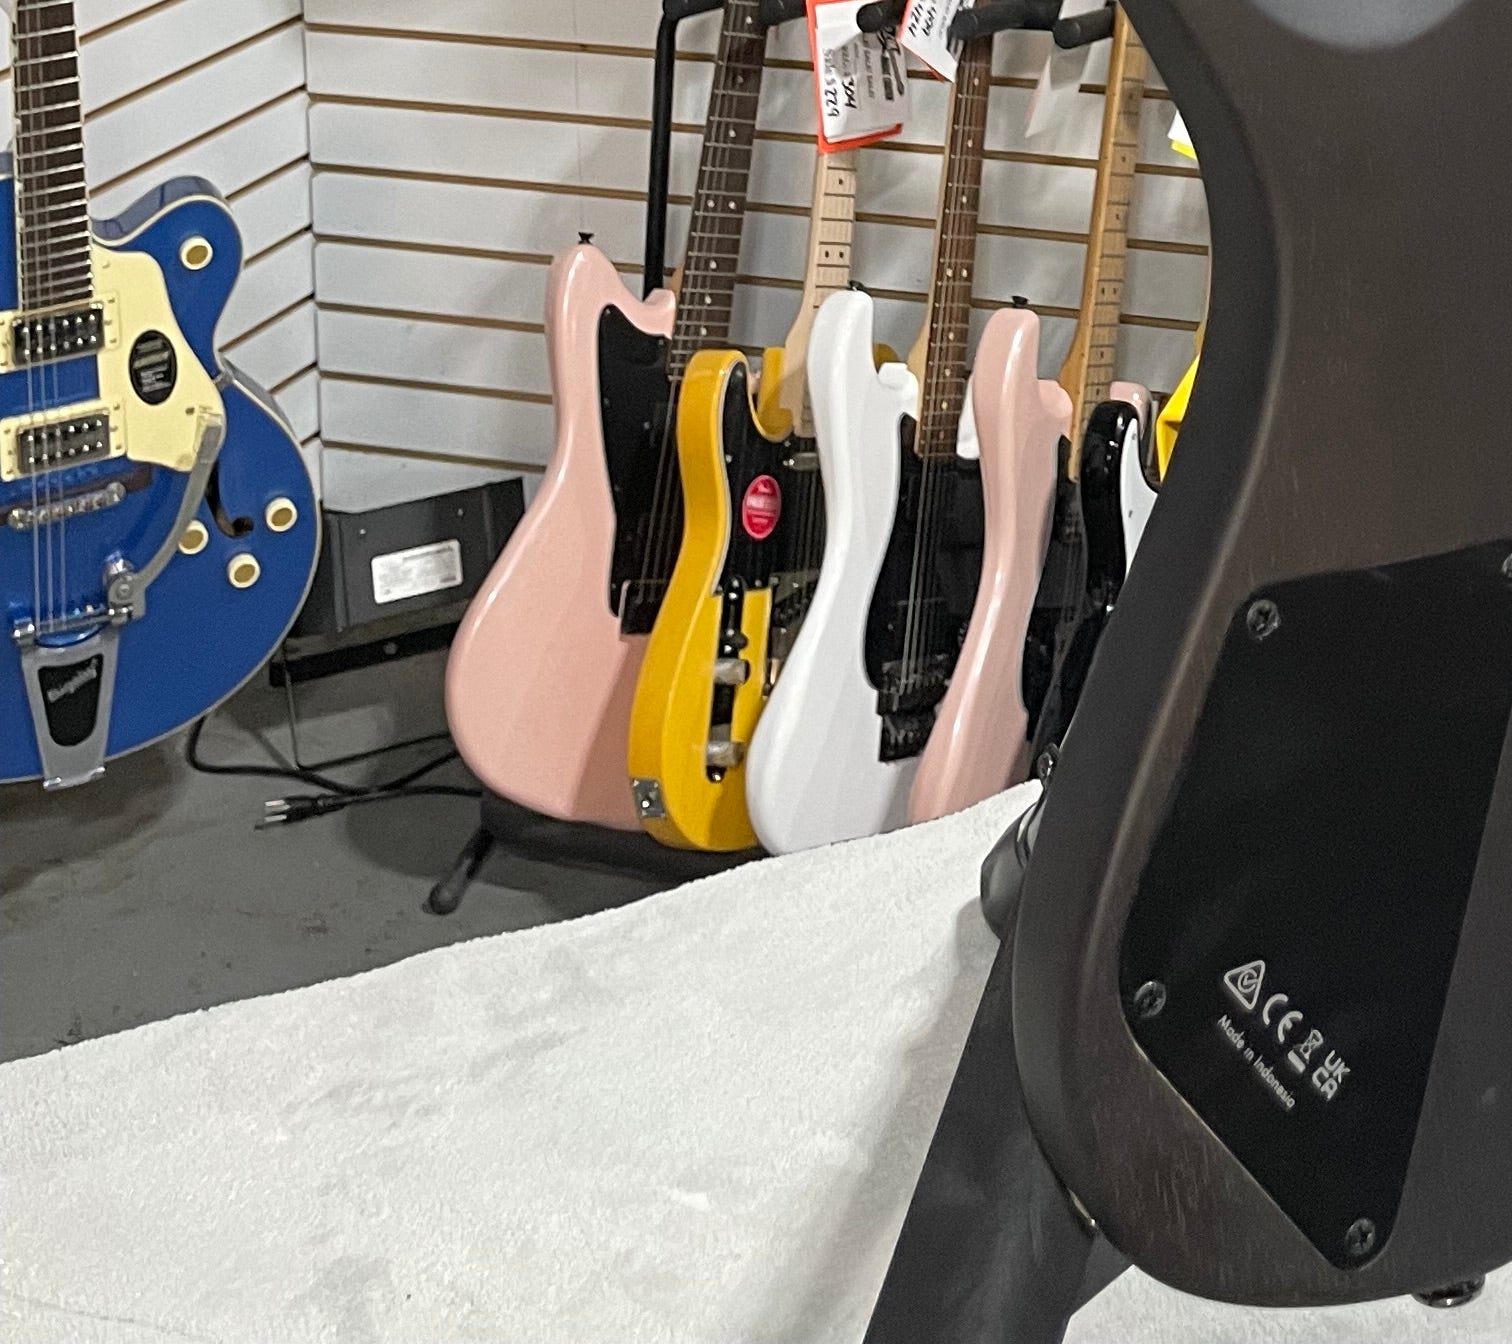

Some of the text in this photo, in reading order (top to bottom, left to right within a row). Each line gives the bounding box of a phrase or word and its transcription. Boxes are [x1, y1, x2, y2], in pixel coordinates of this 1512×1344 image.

[1216, 1013, 1296, 1109] Made in Indonesia
[1323, 1049, 1352, 1084] UK
[1311, 1065, 1339, 1102] CA
